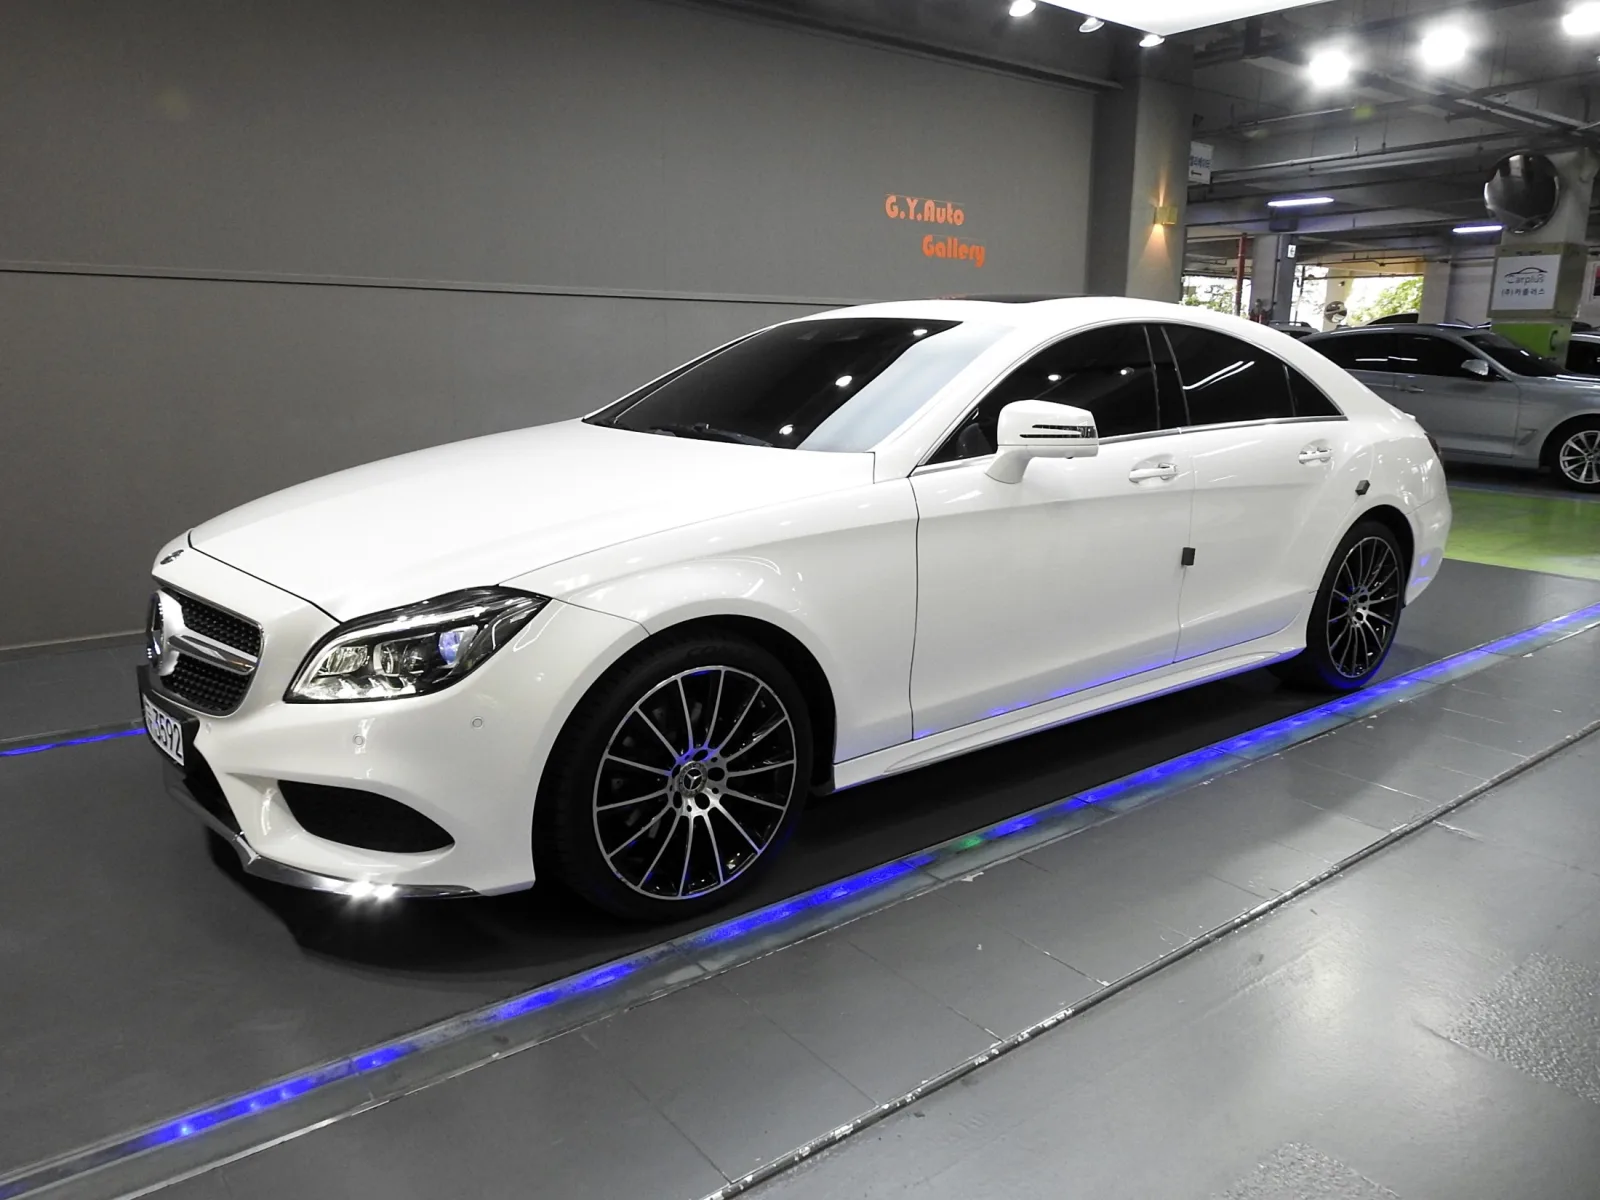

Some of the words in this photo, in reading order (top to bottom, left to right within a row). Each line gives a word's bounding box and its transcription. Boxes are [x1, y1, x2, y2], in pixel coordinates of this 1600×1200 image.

[885, 195, 965, 226] G.Y.Auto
[922, 234, 985, 268] Gallery
[153, 707, 183, 759] 3592
